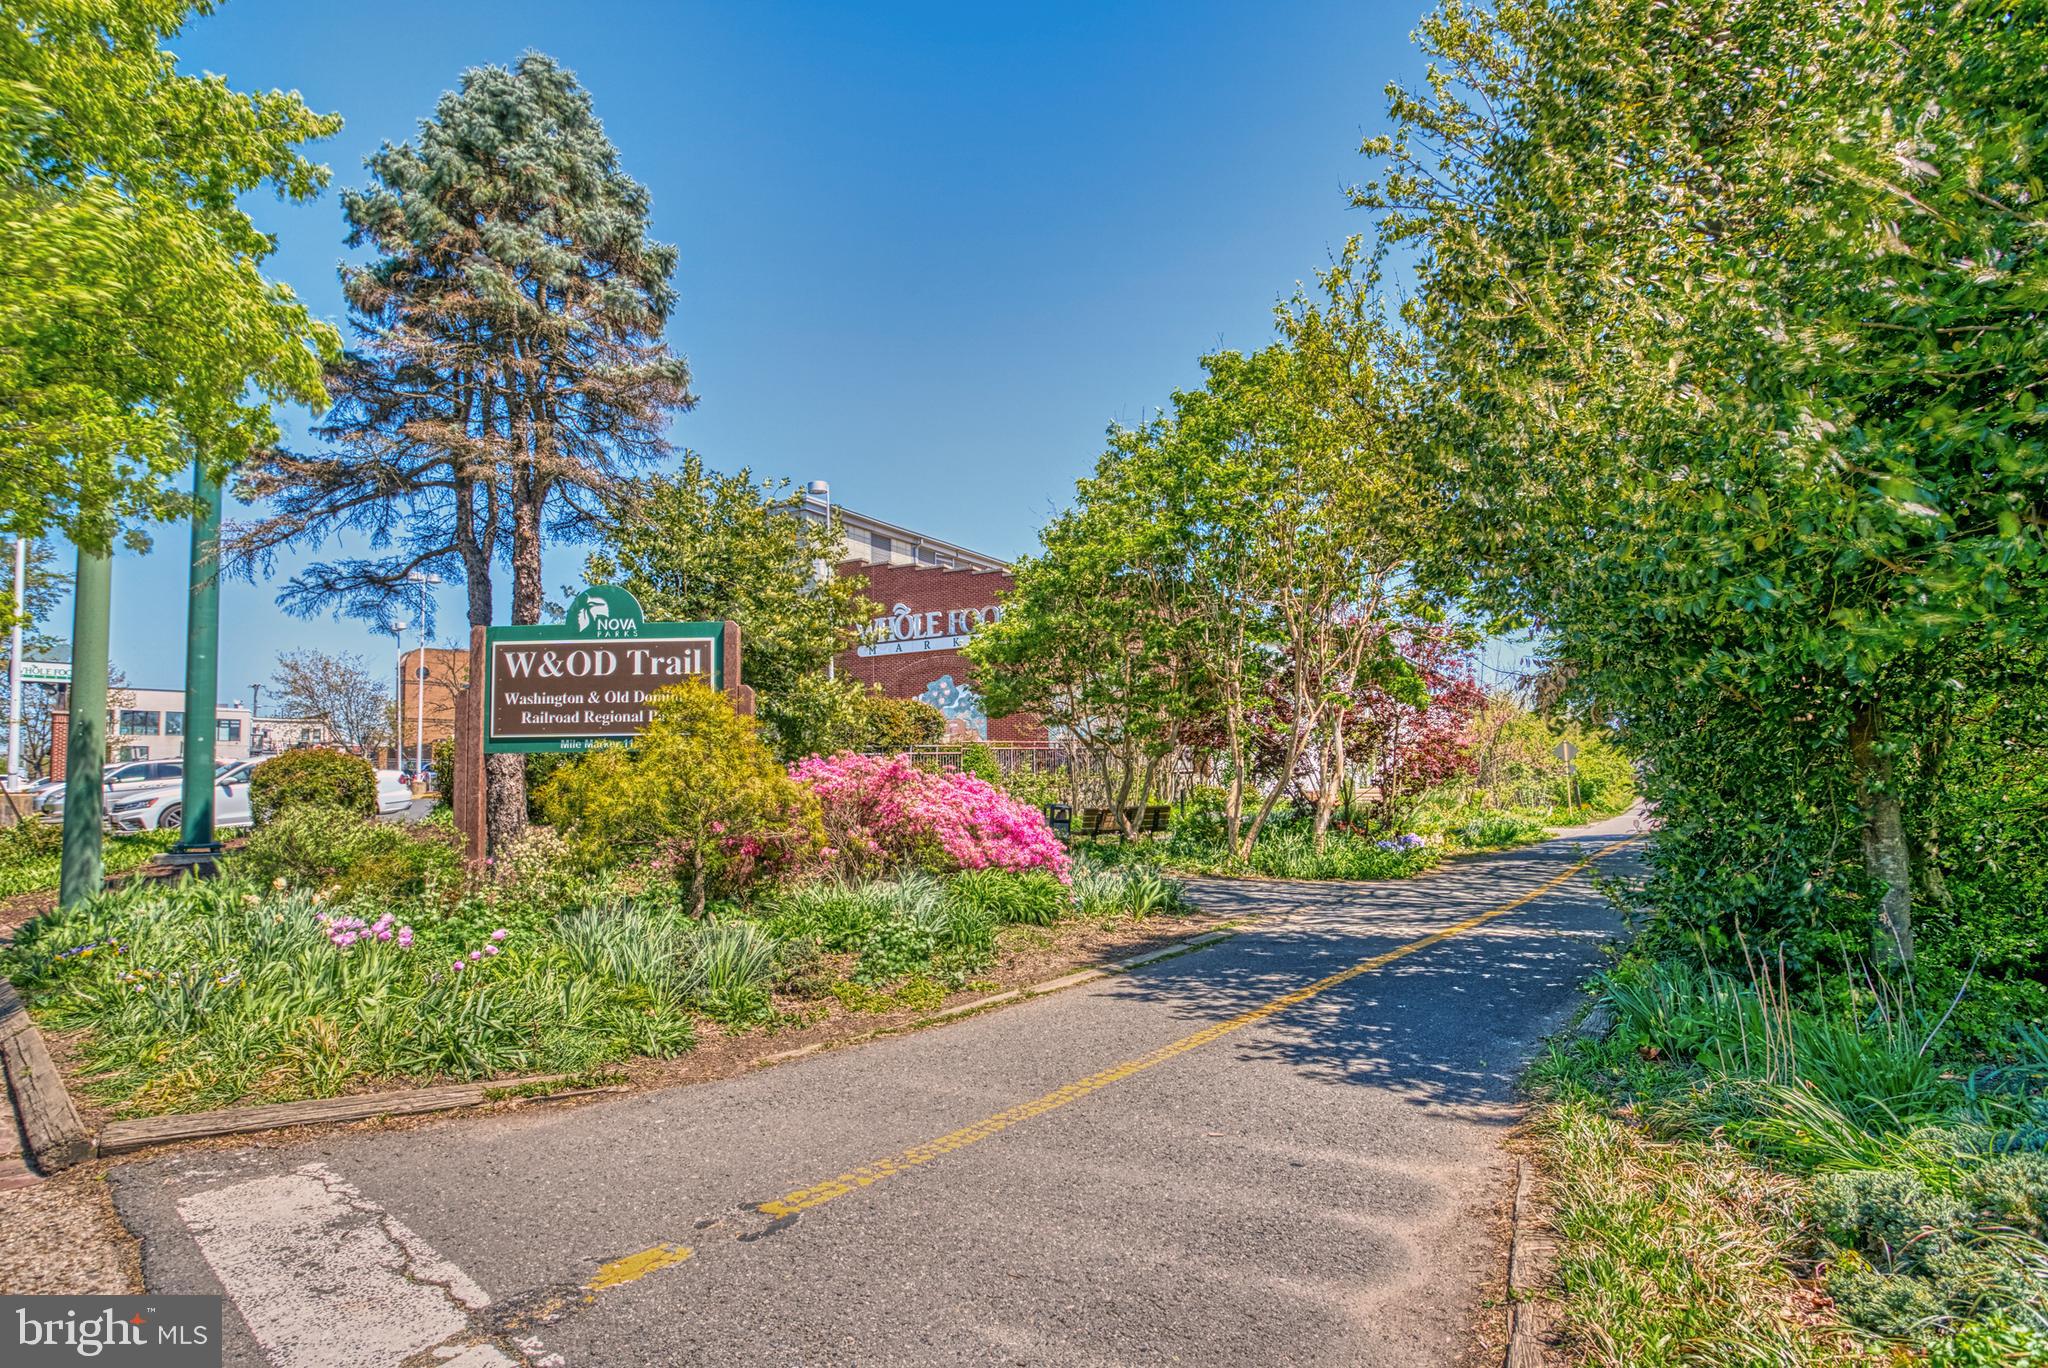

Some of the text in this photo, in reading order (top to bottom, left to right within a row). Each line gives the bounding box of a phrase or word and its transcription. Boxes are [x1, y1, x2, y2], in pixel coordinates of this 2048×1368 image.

[597, 618, 637, 630] NOVA
[504, 648, 701, 678] W&OD Trail
[504, 691, 584, 707] Washington
[588, 691, 600, 704] &
[604, 690, 629, 704] Old
[521, 711, 579, 724] Railroad
[584, 709, 643, 725] Regional
[560, 739, 582, 749] Mile
